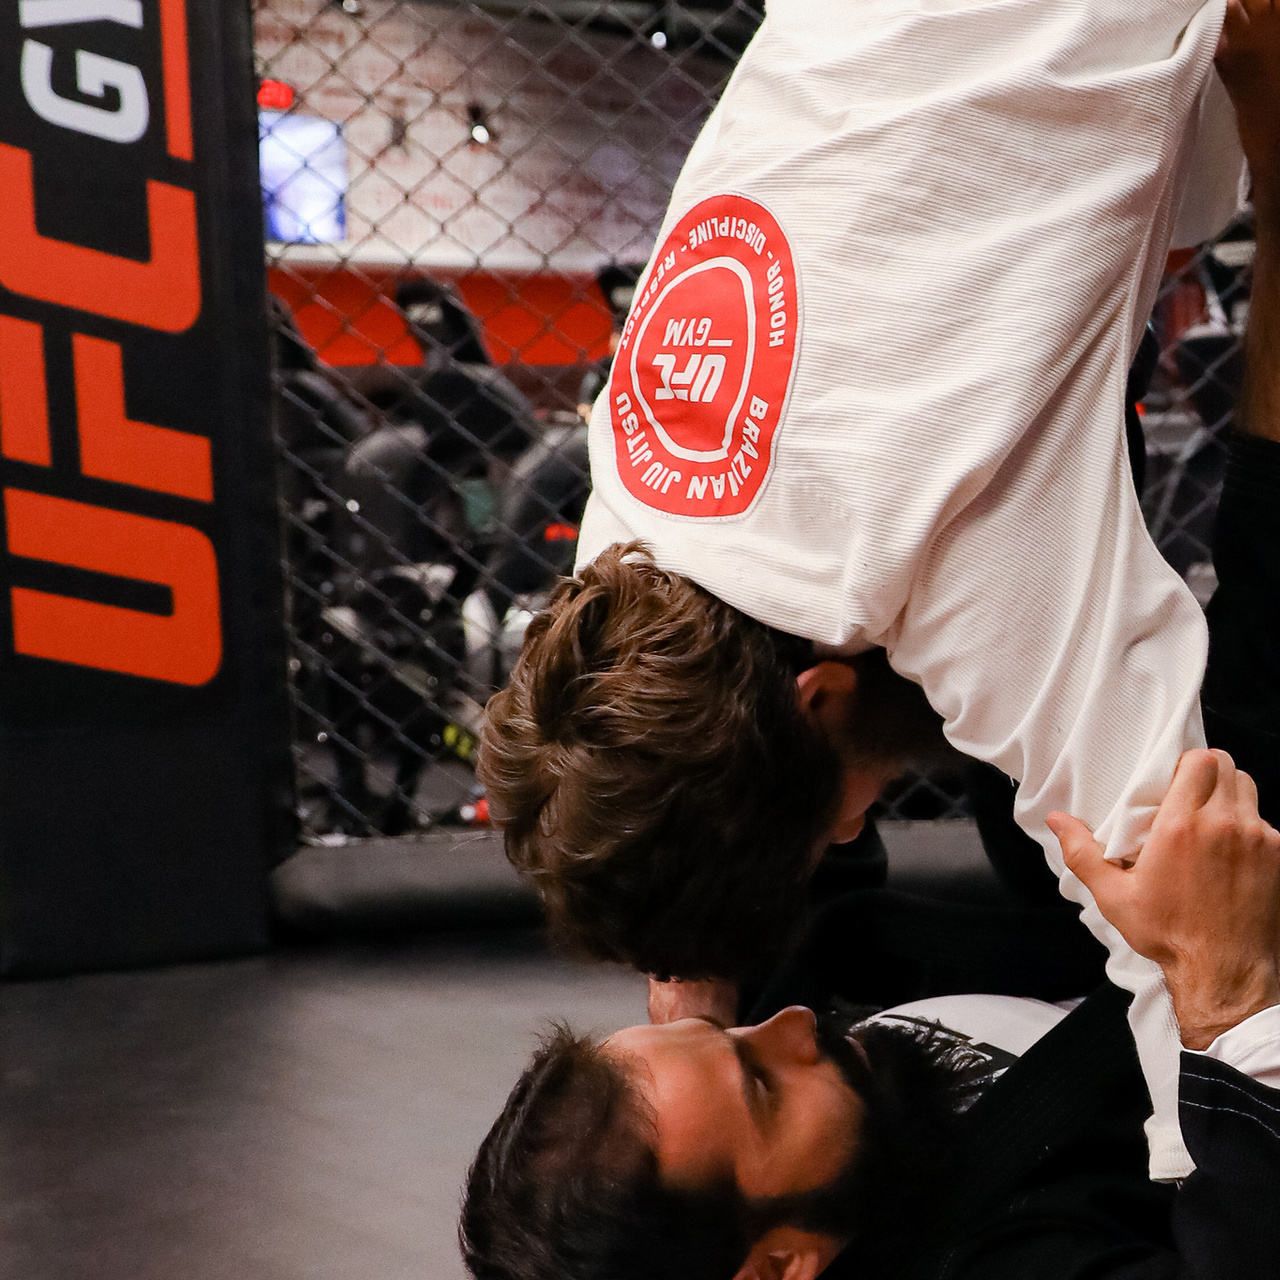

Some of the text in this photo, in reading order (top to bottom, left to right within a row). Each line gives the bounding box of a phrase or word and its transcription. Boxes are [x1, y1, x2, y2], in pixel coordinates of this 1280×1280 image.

[688, 216, 767, 256] DISCIPLINE
[767, 259, 787, 347] HONOR
[661, 317, 712, 347] GYM
[652, 353, 727, 403] UFC
[0, 142, 222, 686] UFC
[615, 392, 654, 468] JITSU
[641, 461, 682, 494] JIU
